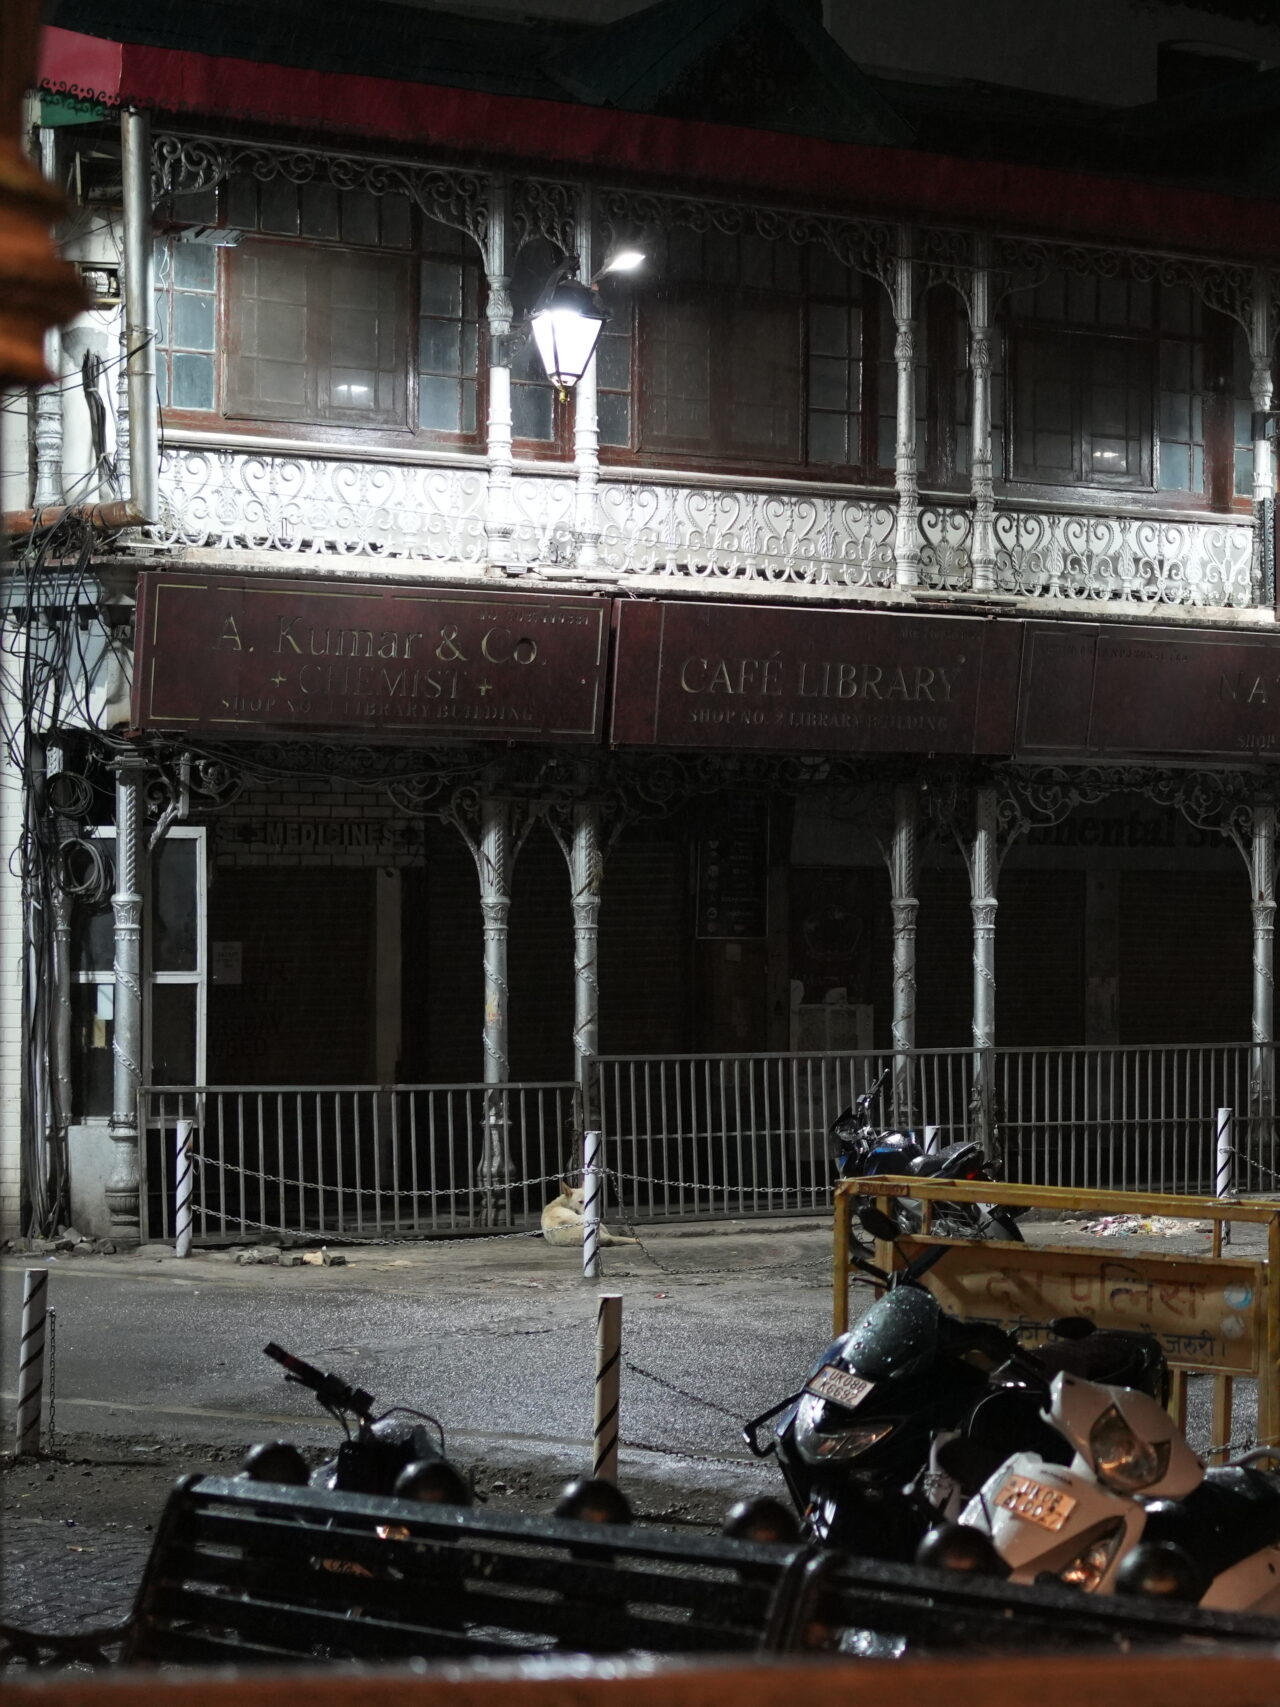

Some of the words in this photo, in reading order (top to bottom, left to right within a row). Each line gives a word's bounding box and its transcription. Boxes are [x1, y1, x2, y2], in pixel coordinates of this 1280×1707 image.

[275, 615, 423, 660] Kumar
[435, 624, 468, 662] &
[299, 663, 465, 699] CHEMIST
[680, 650, 783, 696] CAFÉ
[798, 661, 954, 702] LIBRARY
[221, 697, 276, 715] SHOP
[436, 702, 534, 722] BUILDING
[688, 709, 736, 724] SHOP
[789, 712, 861, 729] LIBRARY
[866, 714, 948, 732] BUILDING
[266, 821, 395, 847] MEDICINES
[1061, 1261, 1207, 1319] पुलिस
